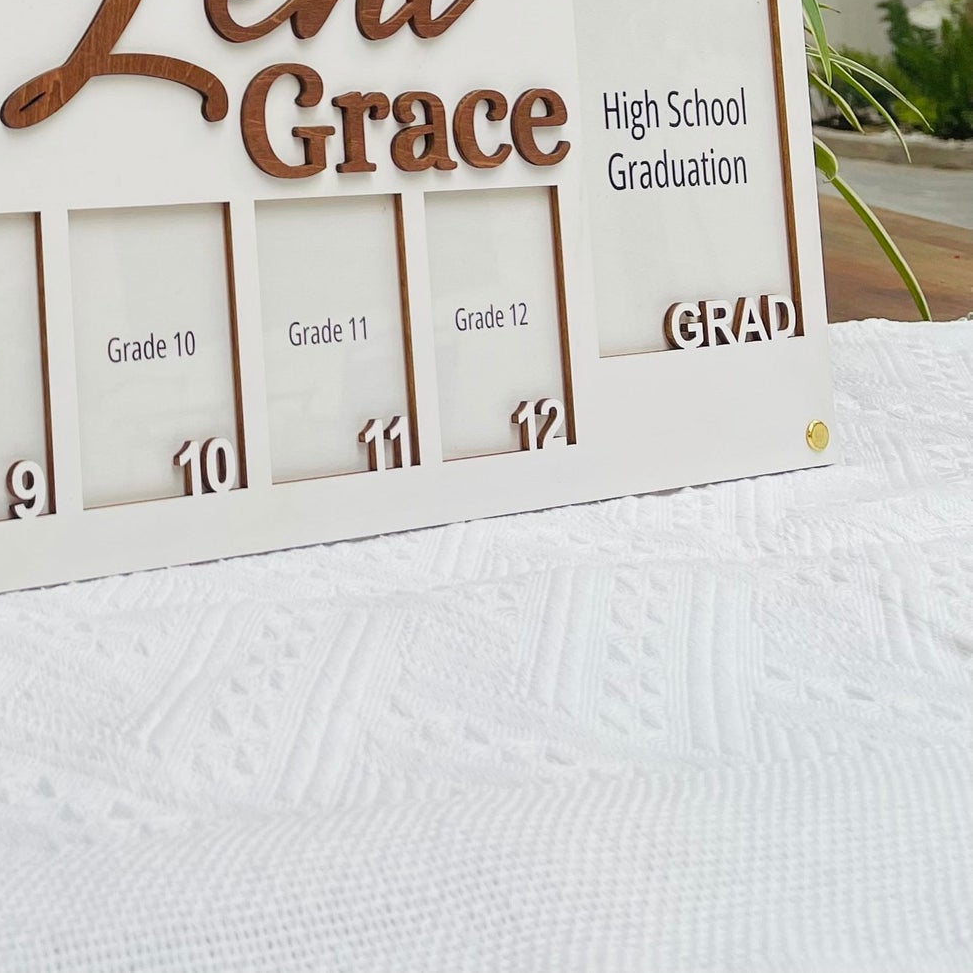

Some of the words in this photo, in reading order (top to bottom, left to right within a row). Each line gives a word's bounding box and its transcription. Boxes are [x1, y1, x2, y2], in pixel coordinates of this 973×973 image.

[240, 63, 571, 179] Grace
[602, 88, 660, 141] High
[667, 86, 747, 128] School
[607, 147, 748, 191] Graduation
[288, 317, 343, 347] Grade
[348, 315, 367, 341] 11
[454, 303, 505, 332] Grade
[509, 302, 529, 327] 12
[663, 294, 797, 349] GRAD
[107, 332, 167, 364] Grade
[173, 330, 196, 357] 10
[358, 415, 411, 471] 11
[511, 397, 568, 452] 12
[6, 459, 46, 520] 9
[172, 437, 237, 497] 10
